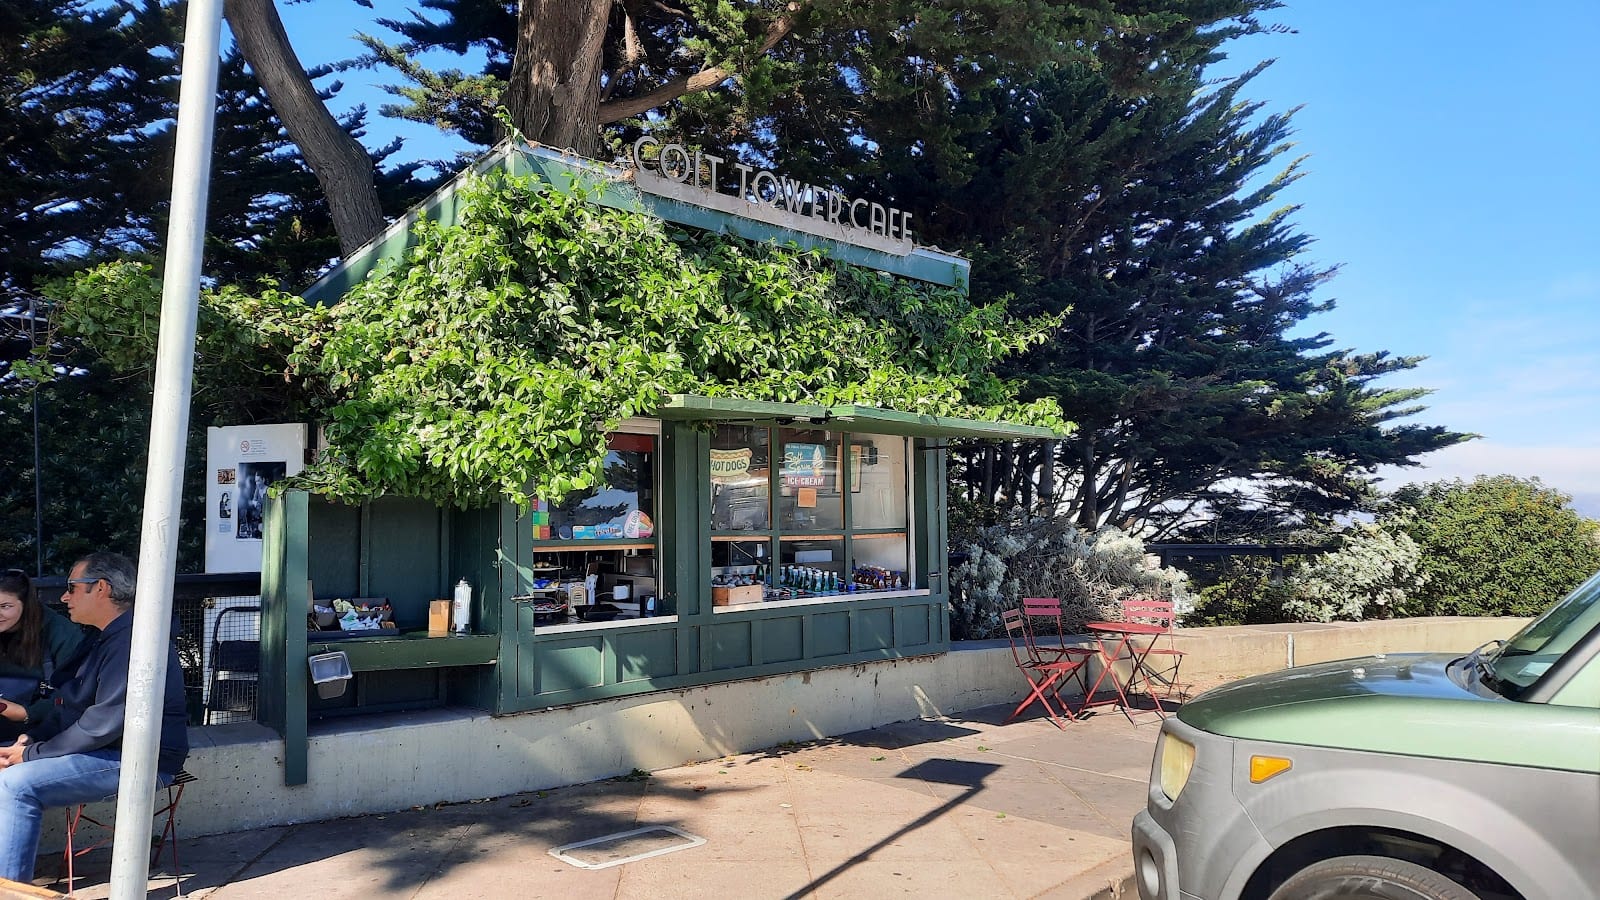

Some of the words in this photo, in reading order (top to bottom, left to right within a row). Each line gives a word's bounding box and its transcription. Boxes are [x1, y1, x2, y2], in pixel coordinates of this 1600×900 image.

[633, 135, 724, 193] COIT
[735, 163, 842, 224] TOWER
[850, 198, 913, 241] CAFE
[711, 460, 725, 471] HOT
[726, 458, 747, 472] DOGS
[787, 476, 799, 486] ICE
[800, 477, 824, 486] CREAM
